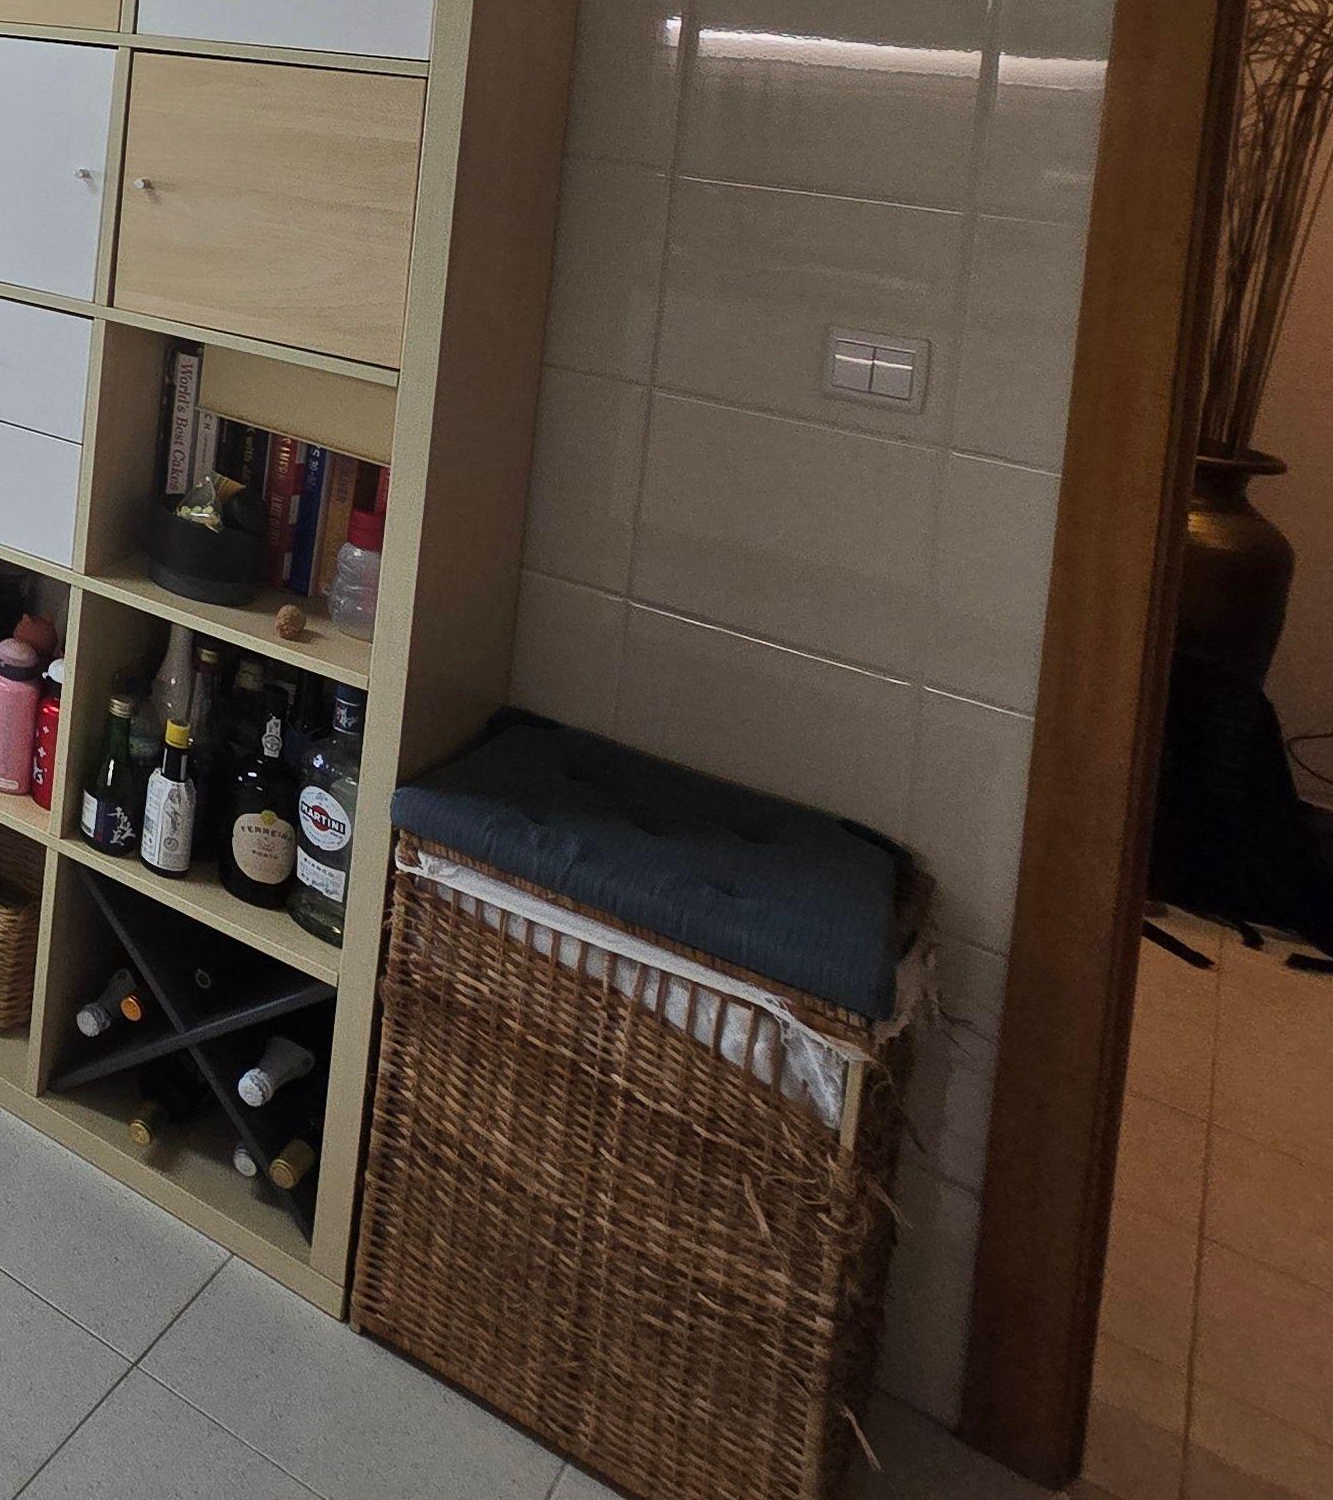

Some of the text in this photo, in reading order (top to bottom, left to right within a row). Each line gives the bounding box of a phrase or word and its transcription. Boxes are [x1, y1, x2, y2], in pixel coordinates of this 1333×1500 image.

[169, 363, 194, 492] World's Best Cakes
[300, 802, 345, 835] MARTINI
